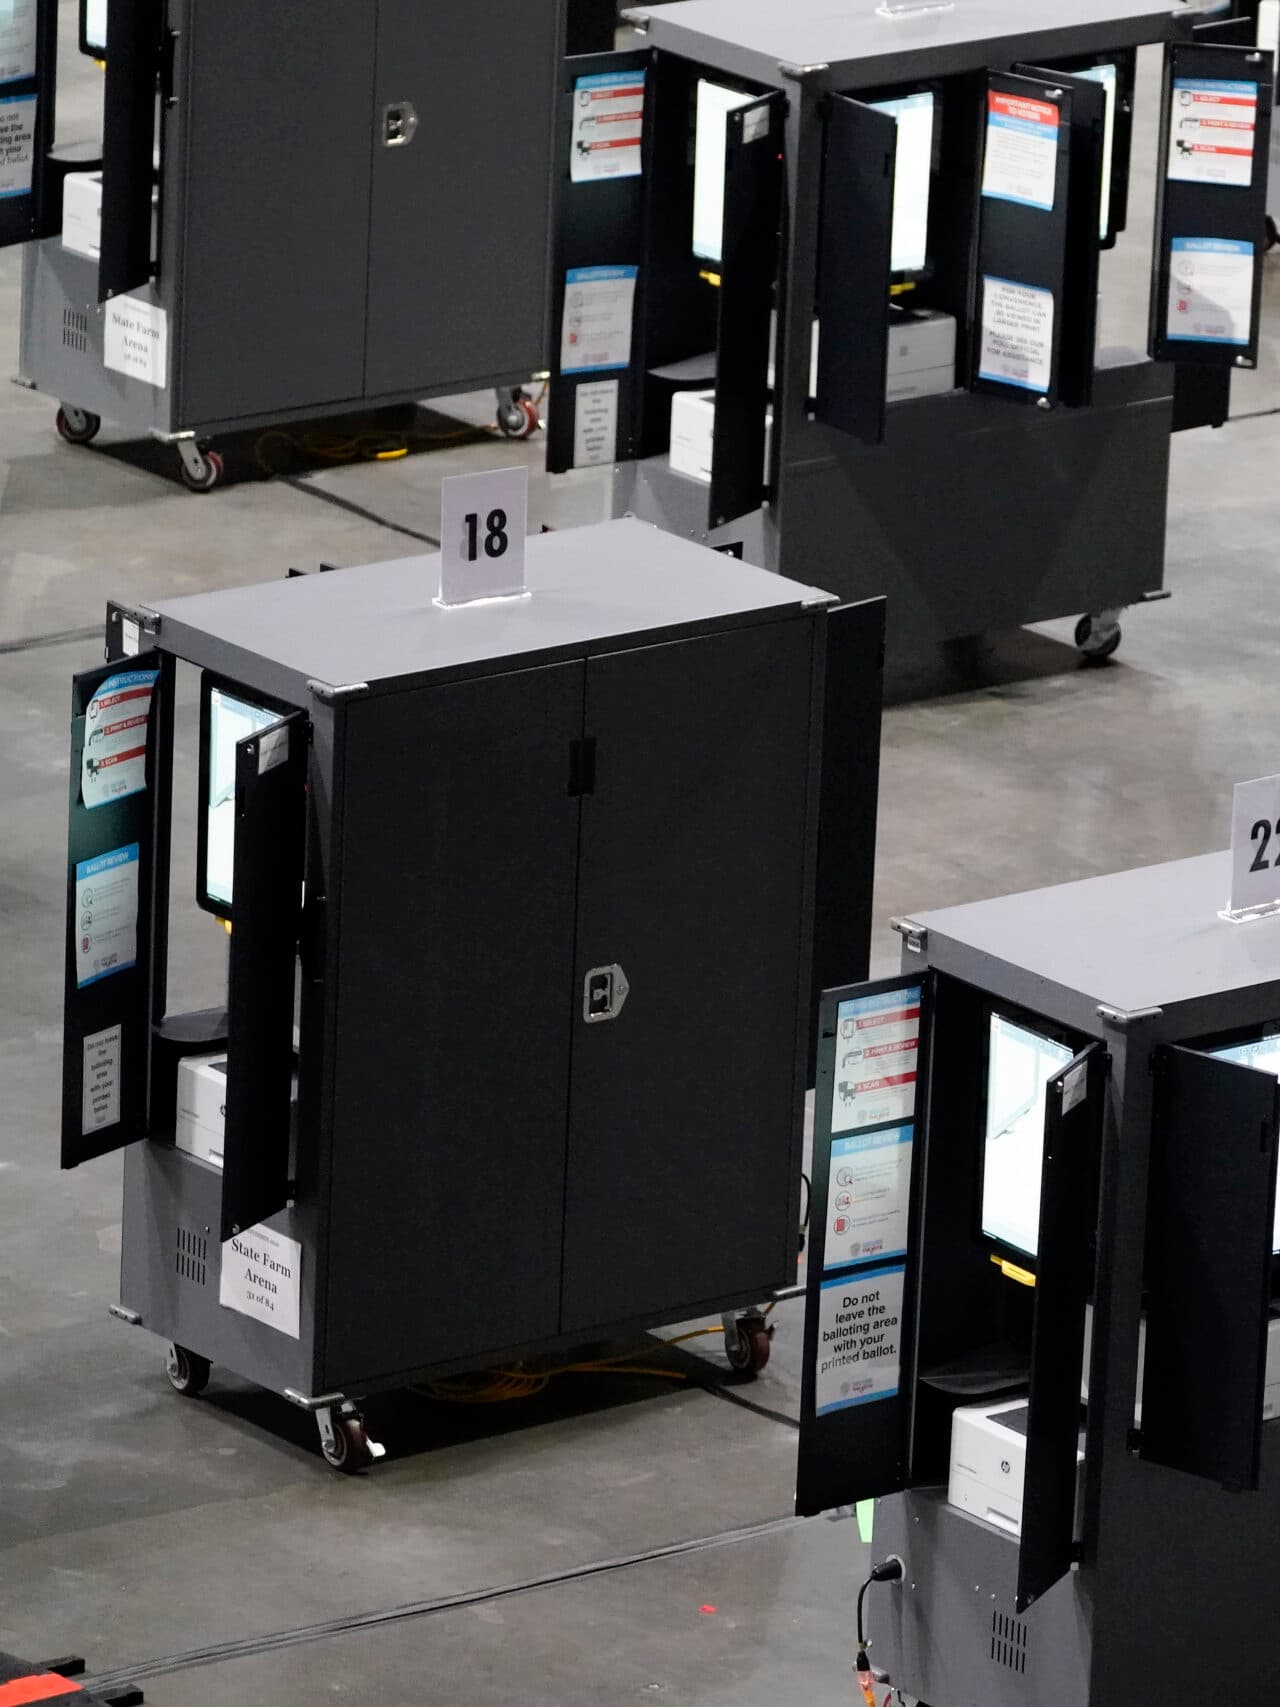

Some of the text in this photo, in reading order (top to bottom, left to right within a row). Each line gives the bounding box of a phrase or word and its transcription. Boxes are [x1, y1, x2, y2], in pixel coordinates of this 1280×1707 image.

[113, 312, 159, 339] State Farm
[123, 336, 148, 353] Arena
[465, 508, 508, 561] 18
[232, 1239, 291, 1278] State Farm
[245, 1268, 277, 1293] Arena
[257, 1296, 264, 1304] of
[843, 1291, 880, 1308] Do not
[835, 1305, 885, 1324] leave the
[823, 1317, 898, 1341] balloting area
[834, 1333, 885, 1353] with your
[821, 1345, 897, 1374] printed ballot.
